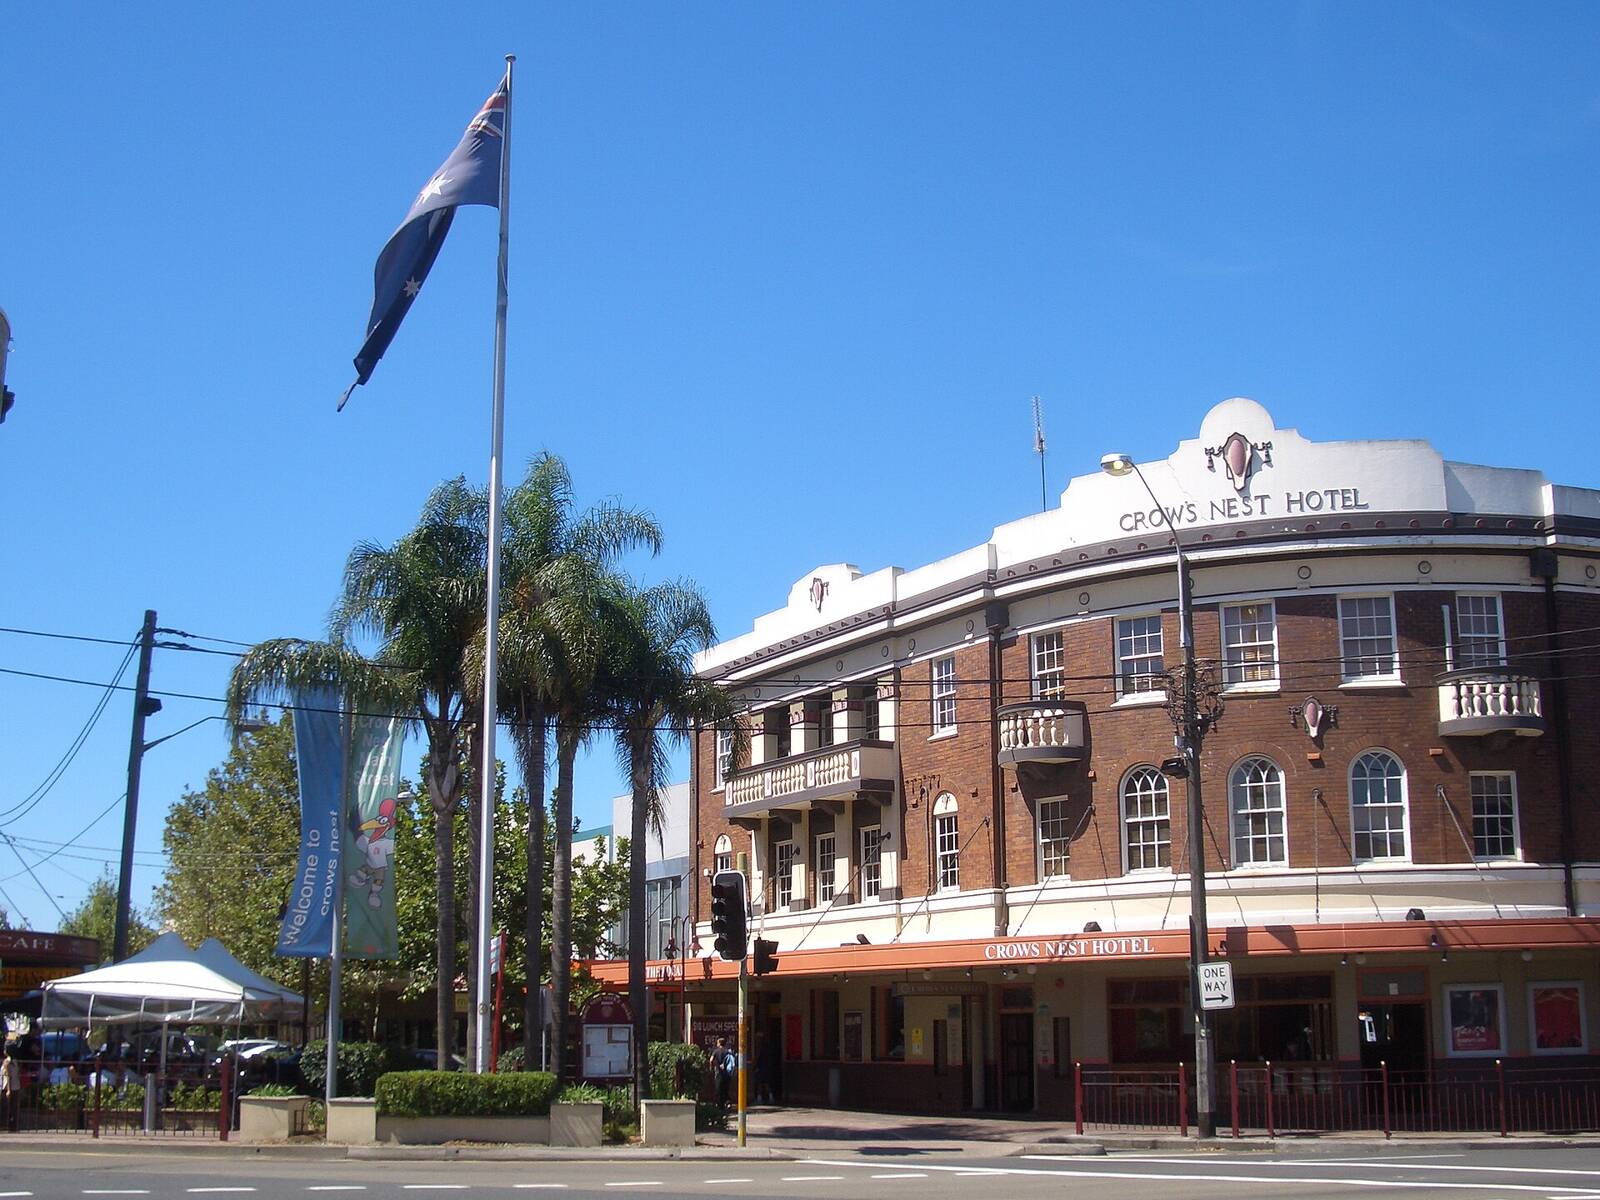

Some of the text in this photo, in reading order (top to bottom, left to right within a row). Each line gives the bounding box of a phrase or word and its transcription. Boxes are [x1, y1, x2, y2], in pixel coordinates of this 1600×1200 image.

[1210, 494, 1271, 521] NEST
[1286, 488, 1369, 513] HOTEL
[282, 829, 320, 945] Welcome to
[319, 858, 338, 916] crows
[984, 938, 1155, 960] CROWS NEST HOTEL
[1203, 967, 1226, 979] ONE
[1204, 981, 1228, 993] WAY
